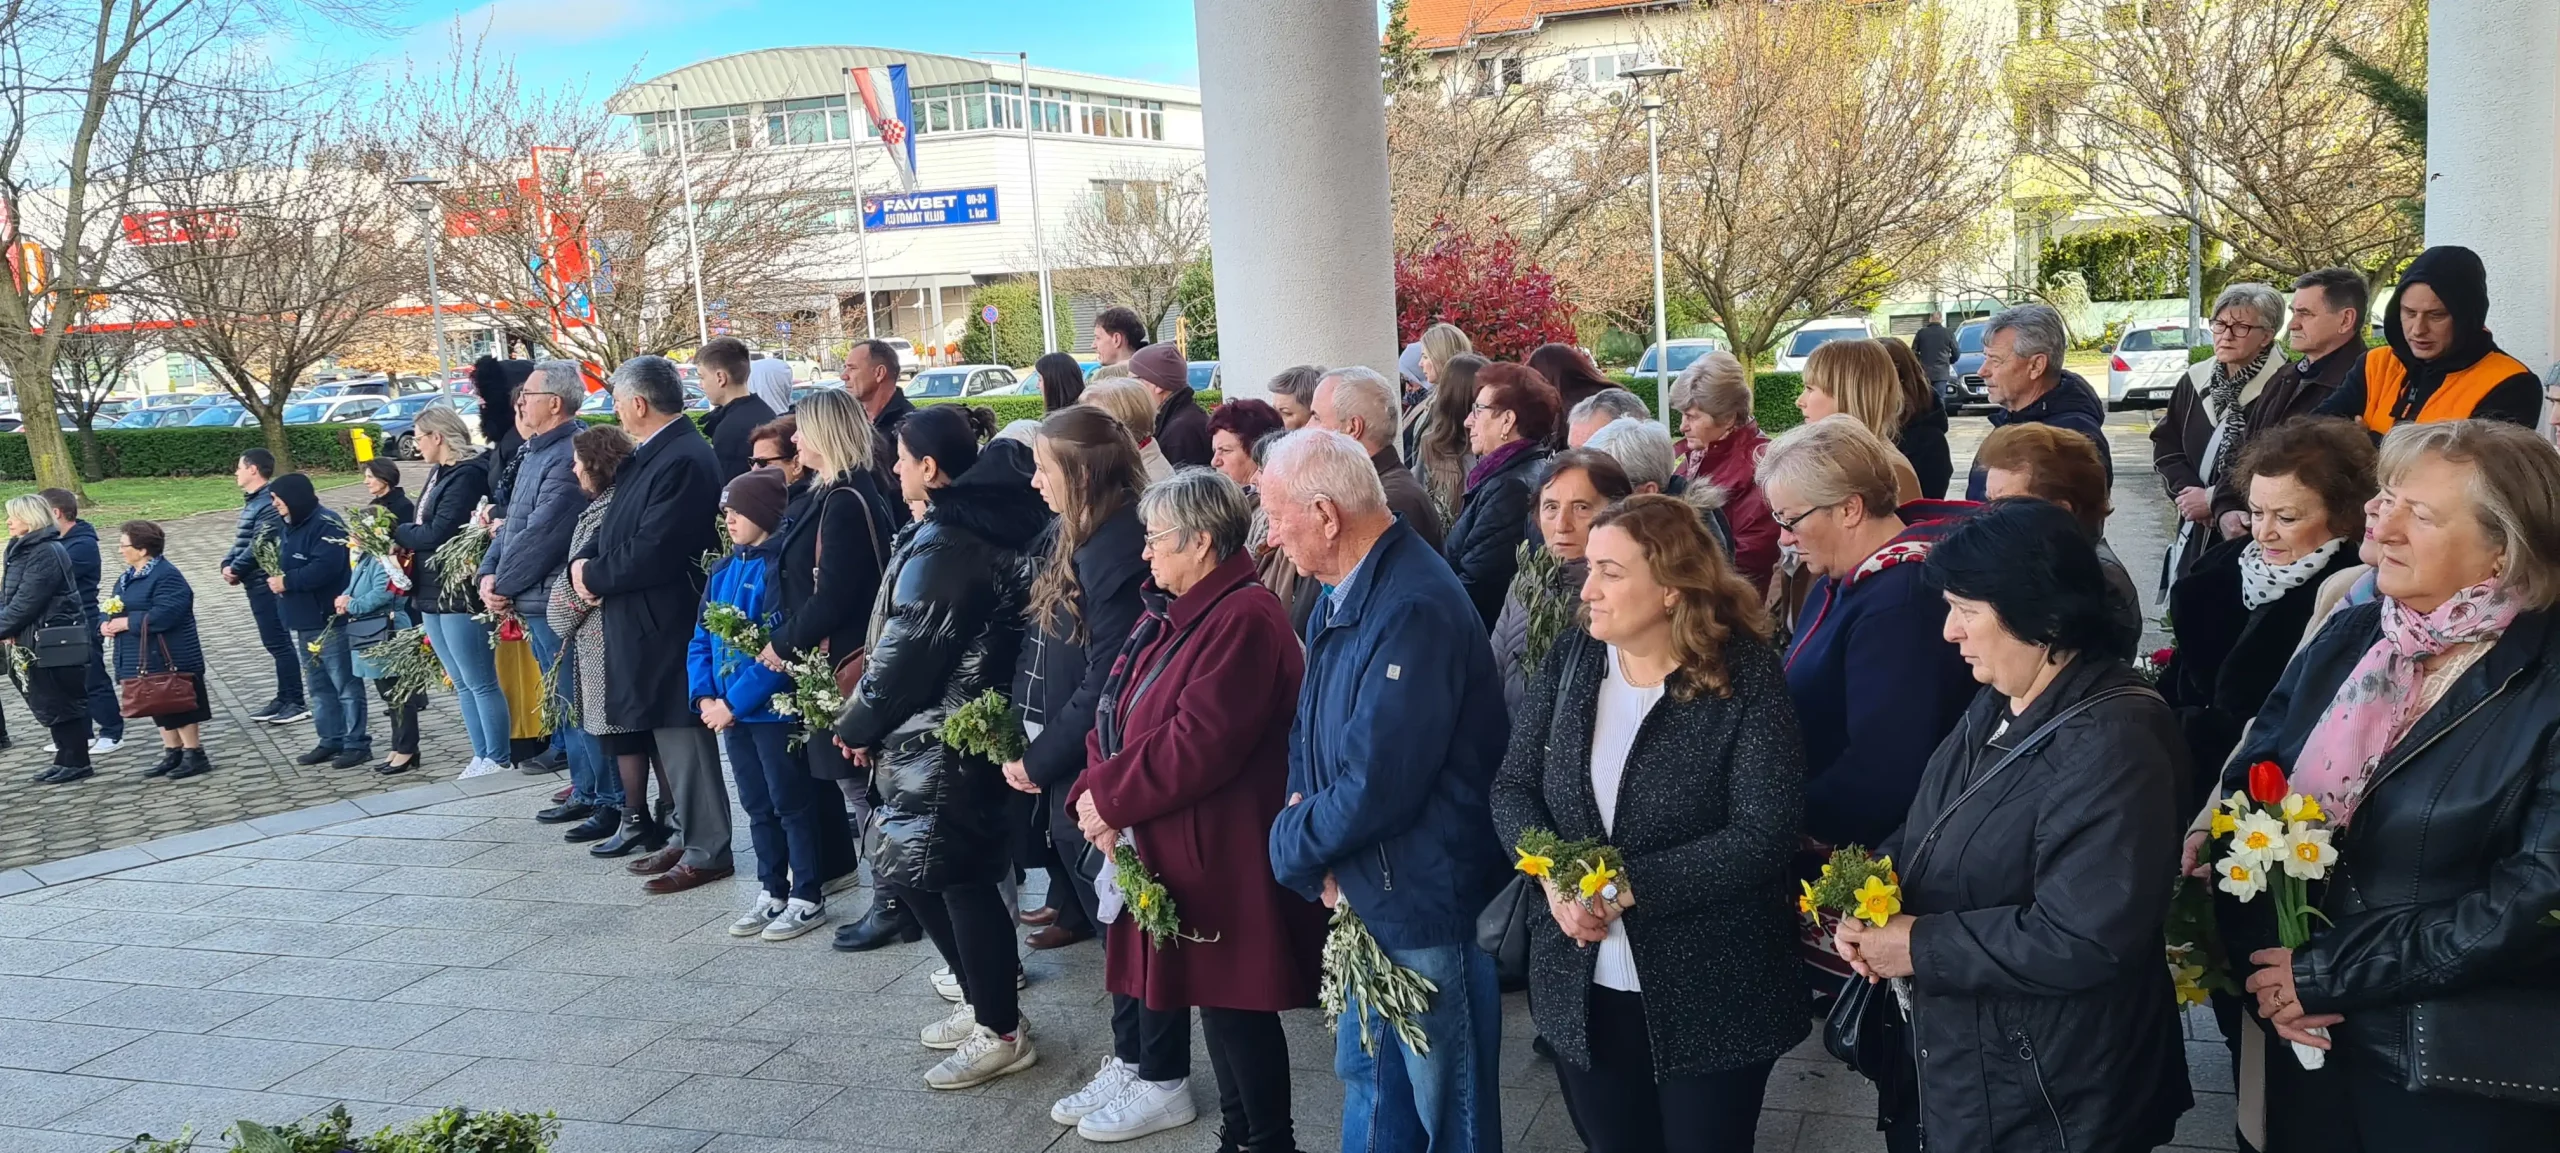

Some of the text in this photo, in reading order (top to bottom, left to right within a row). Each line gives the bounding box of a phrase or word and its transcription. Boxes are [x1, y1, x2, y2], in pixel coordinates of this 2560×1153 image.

[883, 195, 957, 212] FAVBET
[885, 210, 946, 225] AUTOMAT KLUB
[975, 207, 988, 219] kat
